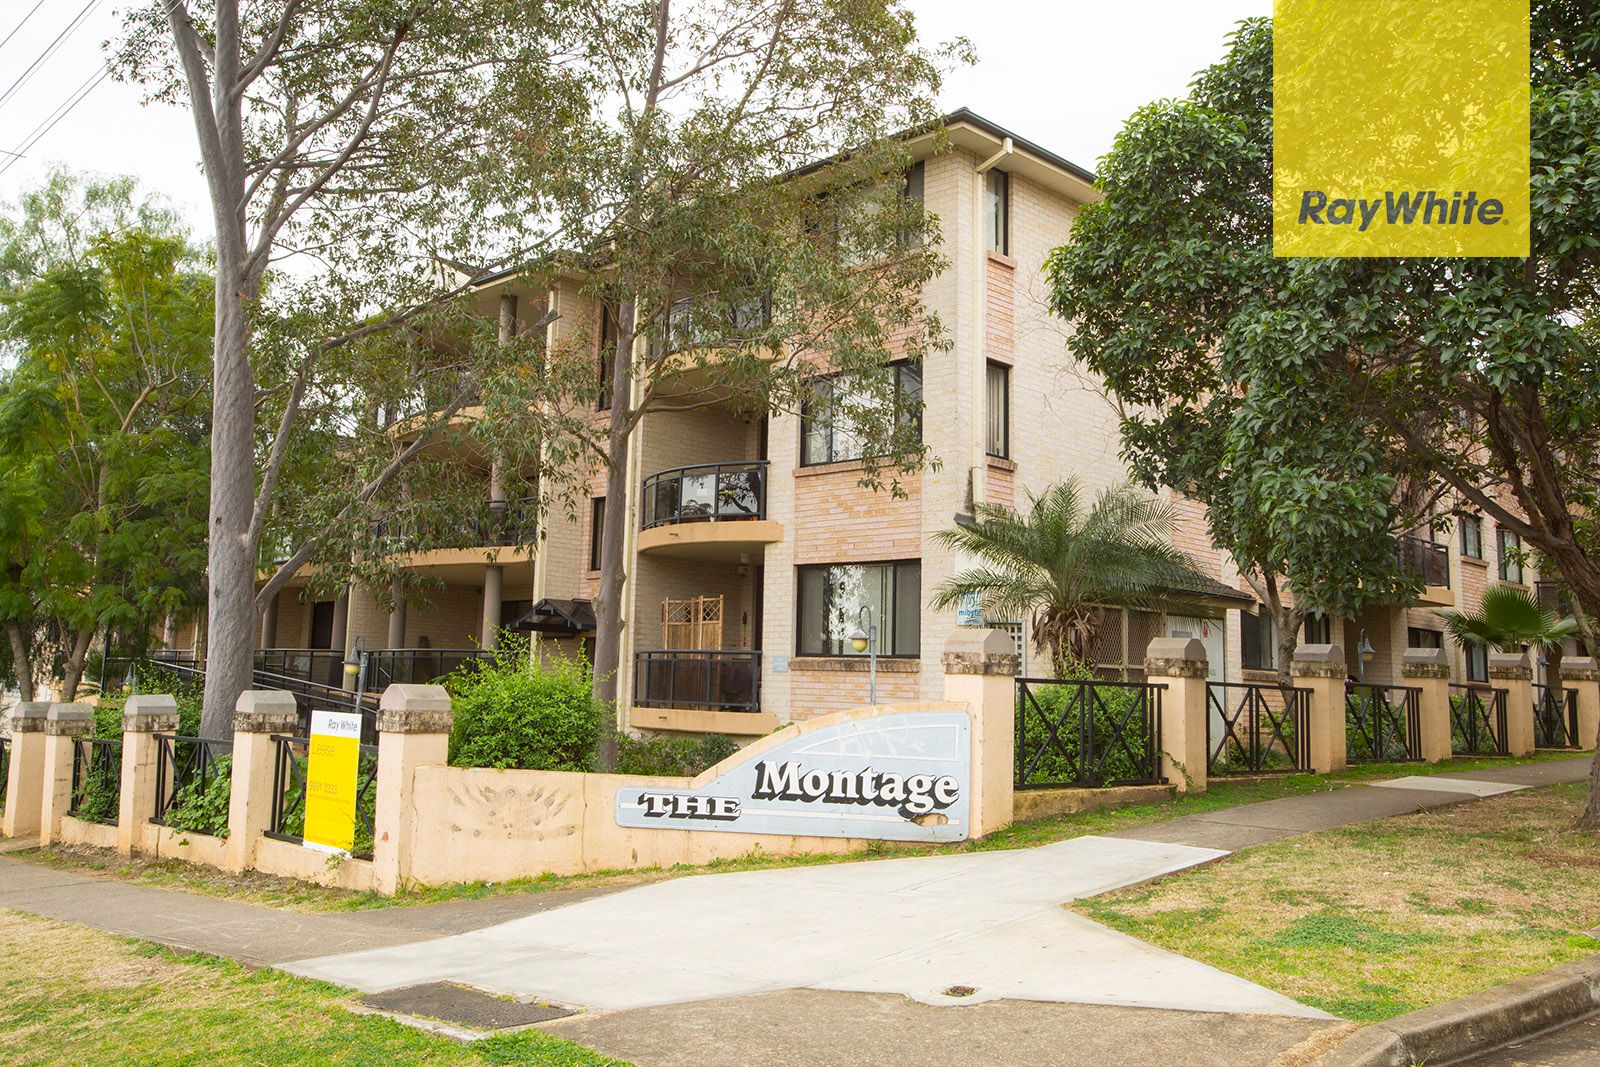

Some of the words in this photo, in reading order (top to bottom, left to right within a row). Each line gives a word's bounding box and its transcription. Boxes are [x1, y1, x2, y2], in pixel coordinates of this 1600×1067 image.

[328, 718, 340, 732] Ray
[340, 720, 358, 732] White
[638, 793, 742, 821] THE
[751, 760, 959, 822] Montage
